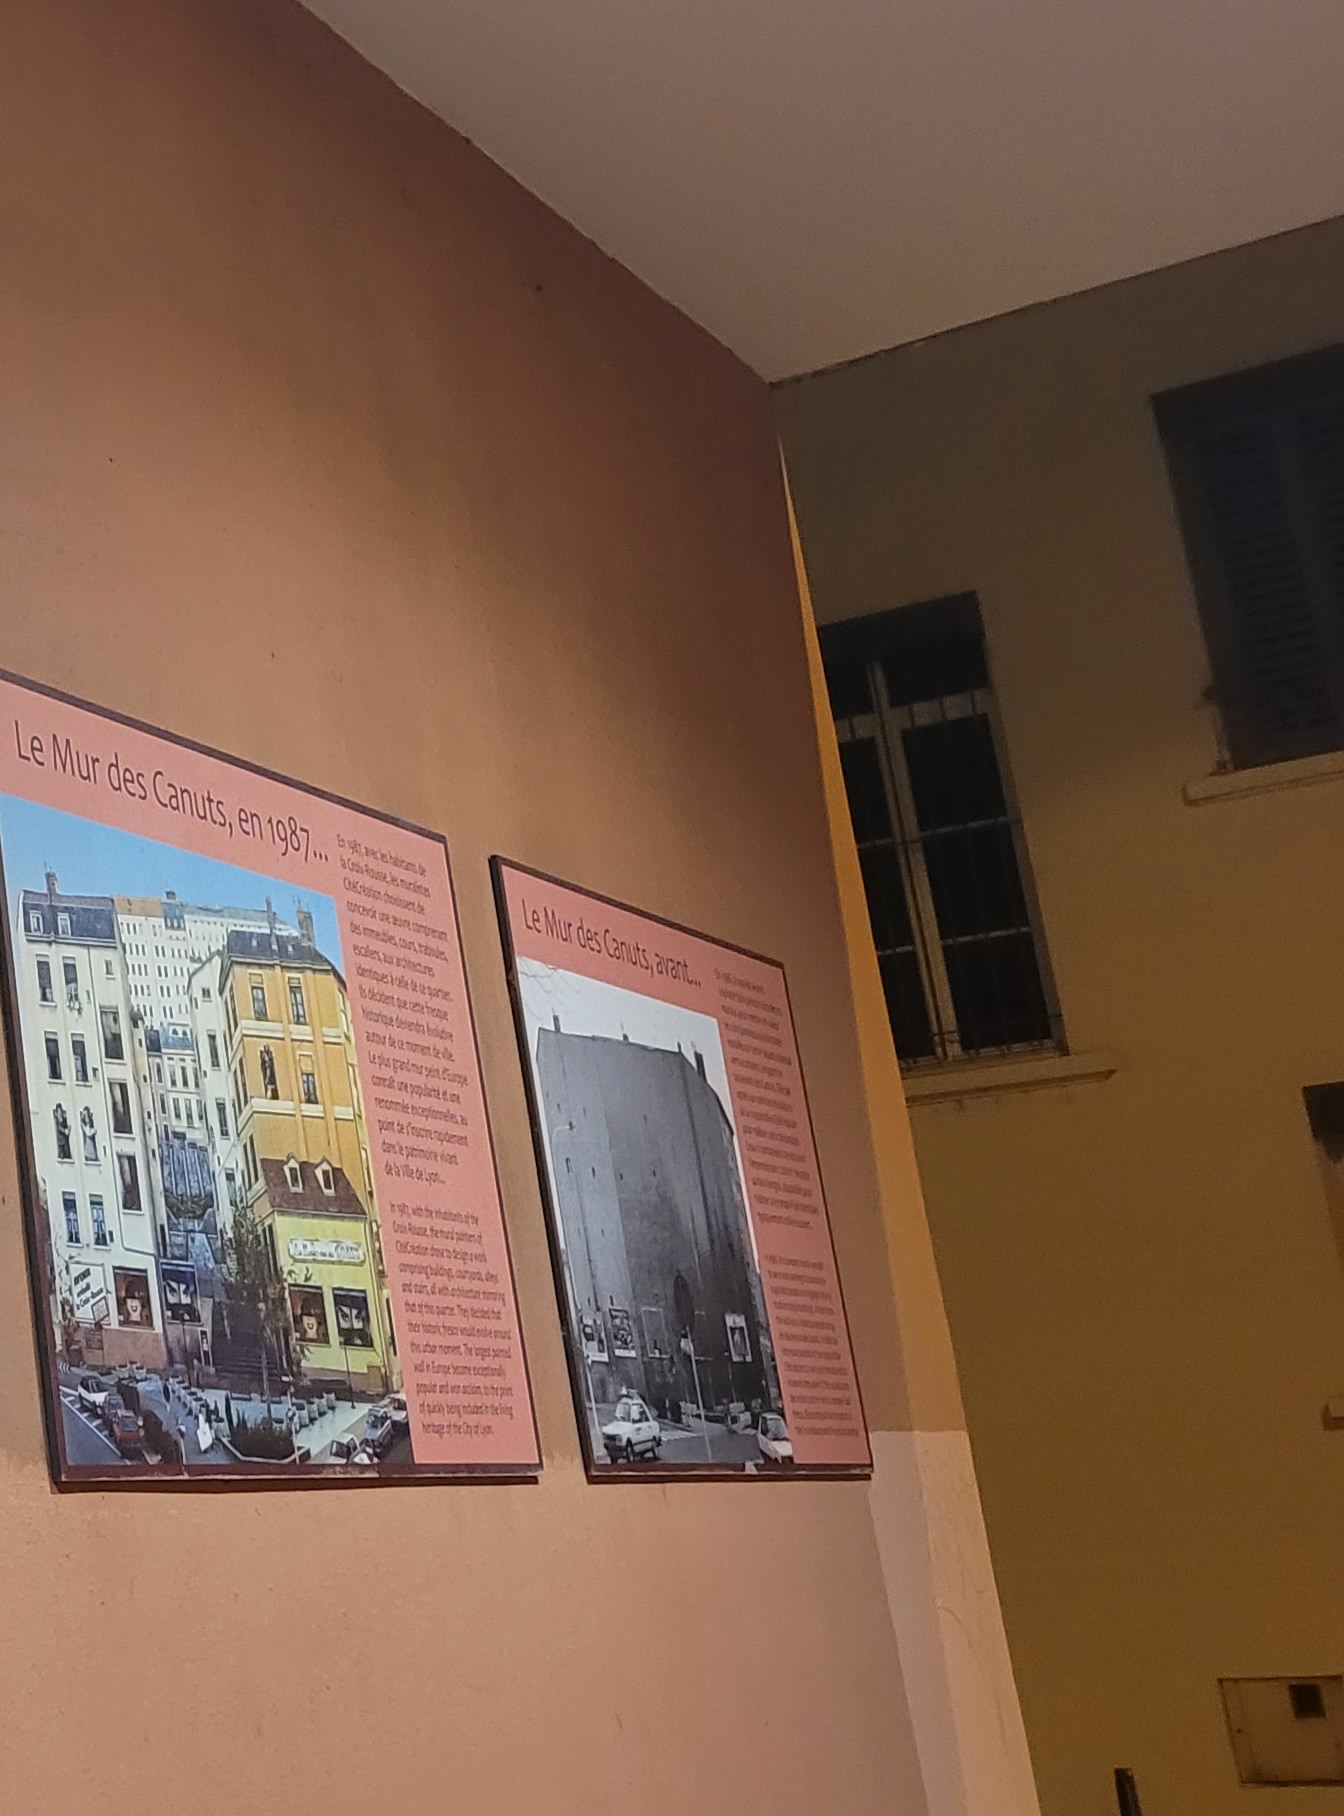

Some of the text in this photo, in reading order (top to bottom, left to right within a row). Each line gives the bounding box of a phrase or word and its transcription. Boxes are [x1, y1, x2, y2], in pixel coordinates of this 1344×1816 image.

[14, 719, 328, 863] Le Mur des Canuts, en 1987...
[521, 898, 701, 987] Le Mur des Canuts, avant...
